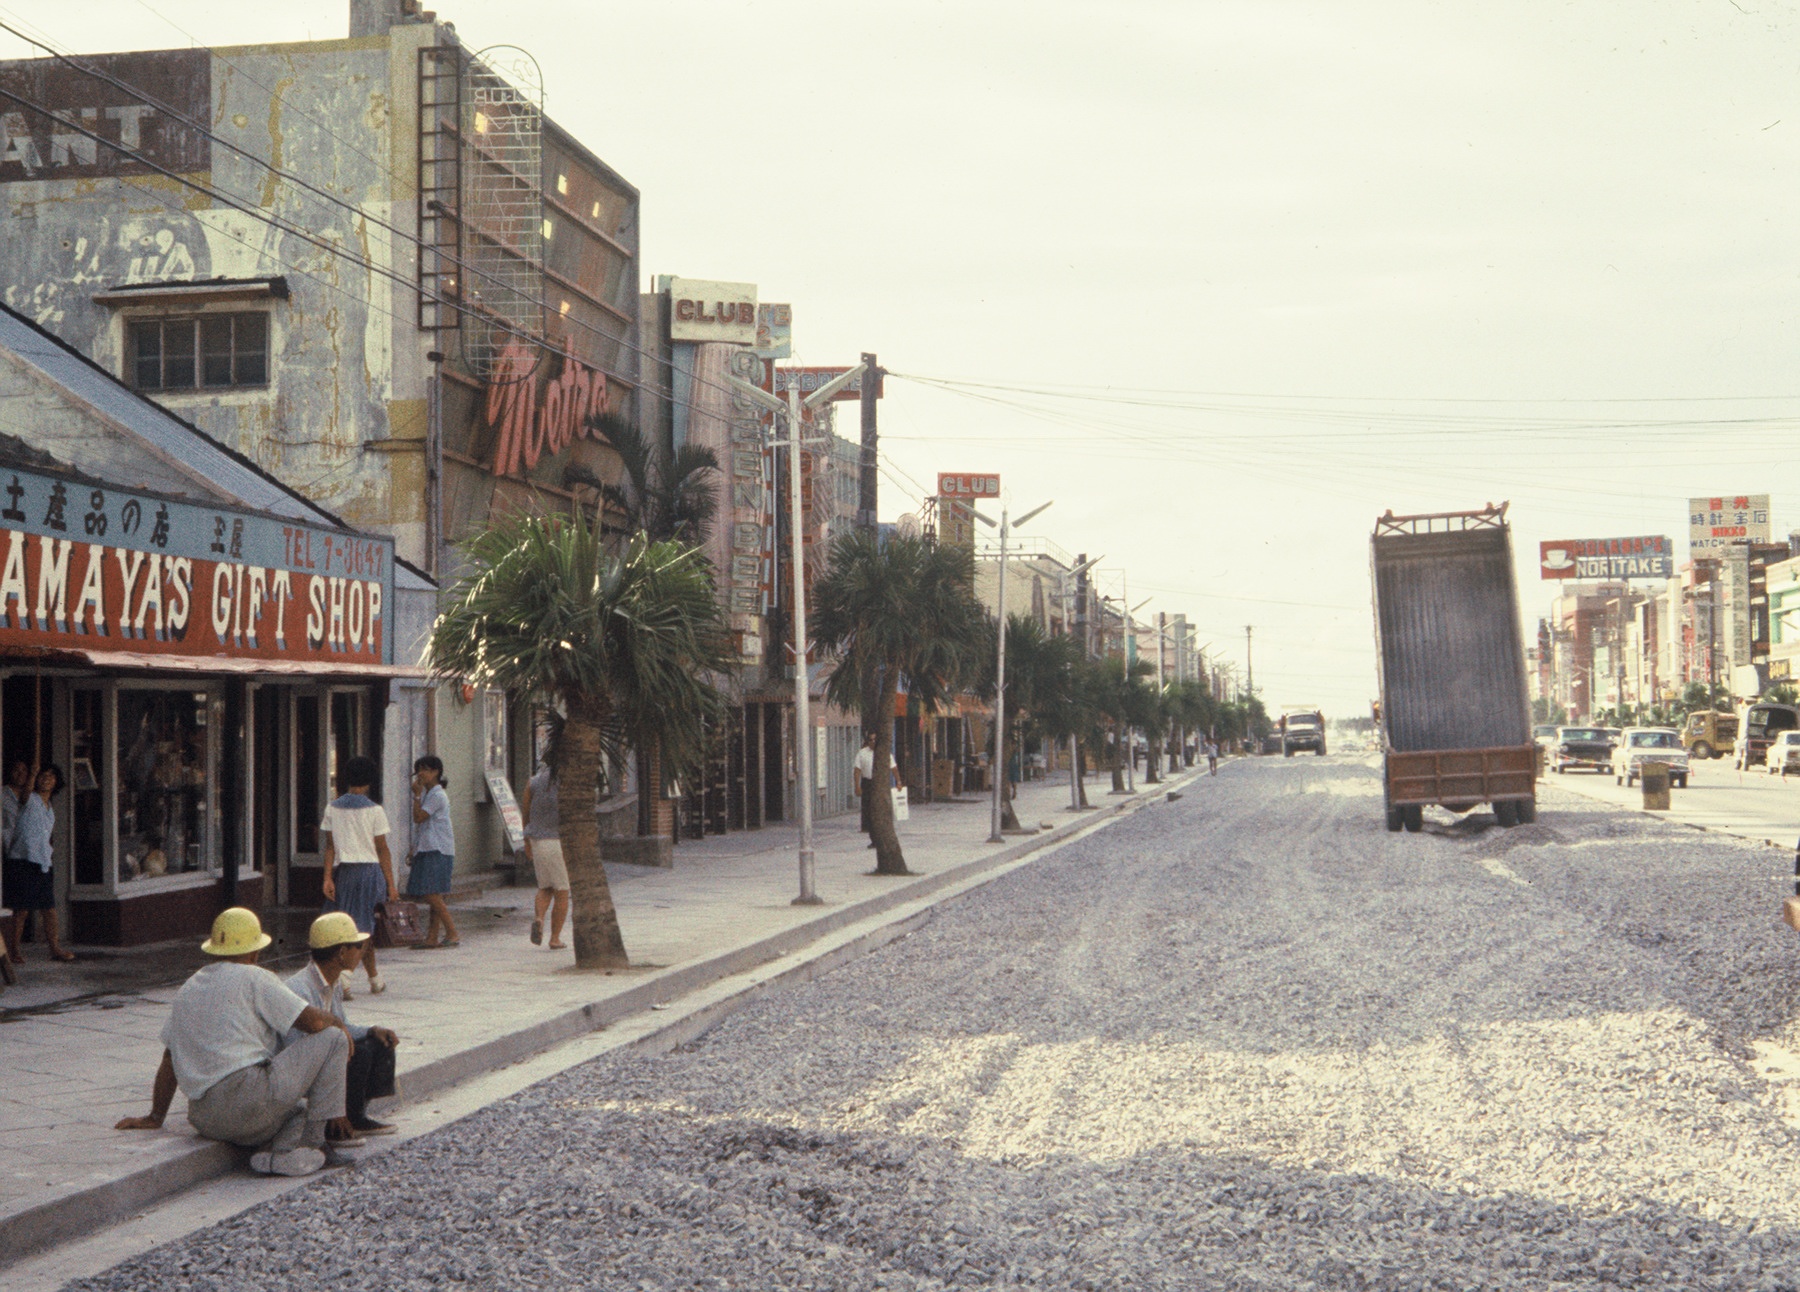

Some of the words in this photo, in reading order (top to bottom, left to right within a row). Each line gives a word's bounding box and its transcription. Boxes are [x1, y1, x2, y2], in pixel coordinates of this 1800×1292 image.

[676, 299, 755, 324] CLUB
[942, 476, 998, 494] CLUB
[2, 475, 170, 548] 土産品の店
[1709, 496, 1749, 510] 日光
[1711, 526, 1747, 537] NIKKO
[283, 527, 315, 569] TEL
[1690, 539, 1725, 548] WATCH
[731, 522, 762, 616] BEE
[1576, 557, 1663, 577] NORITAKE
[0, 530, 192, 634] AMAYA'S
[212, 562, 292, 642] GIFT
[307, 574, 382, 648] SHOP
